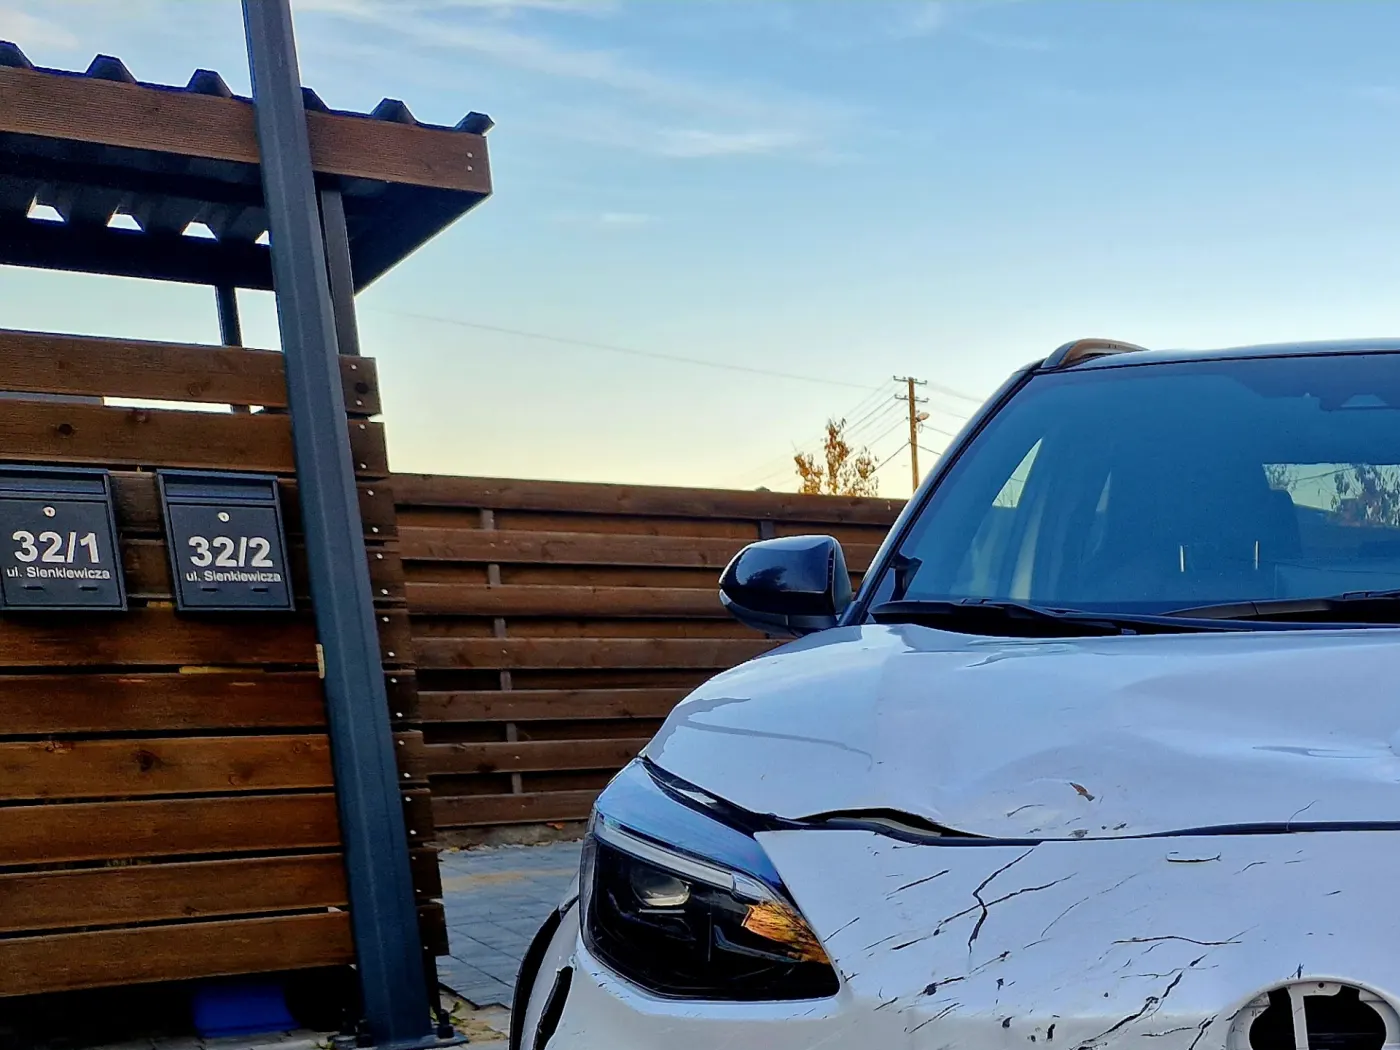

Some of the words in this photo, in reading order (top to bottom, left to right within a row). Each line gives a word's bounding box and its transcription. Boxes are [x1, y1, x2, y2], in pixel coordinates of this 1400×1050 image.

[12, 530, 100, 564] 32/1
[188, 536, 274, 568] 32/2
[6, 566, 22, 578] ul.
[26, 566, 111, 580] Sienkiewicza
[186, 570, 201, 582] ul.
[203, 570, 282, 583] Sienkiewicza
